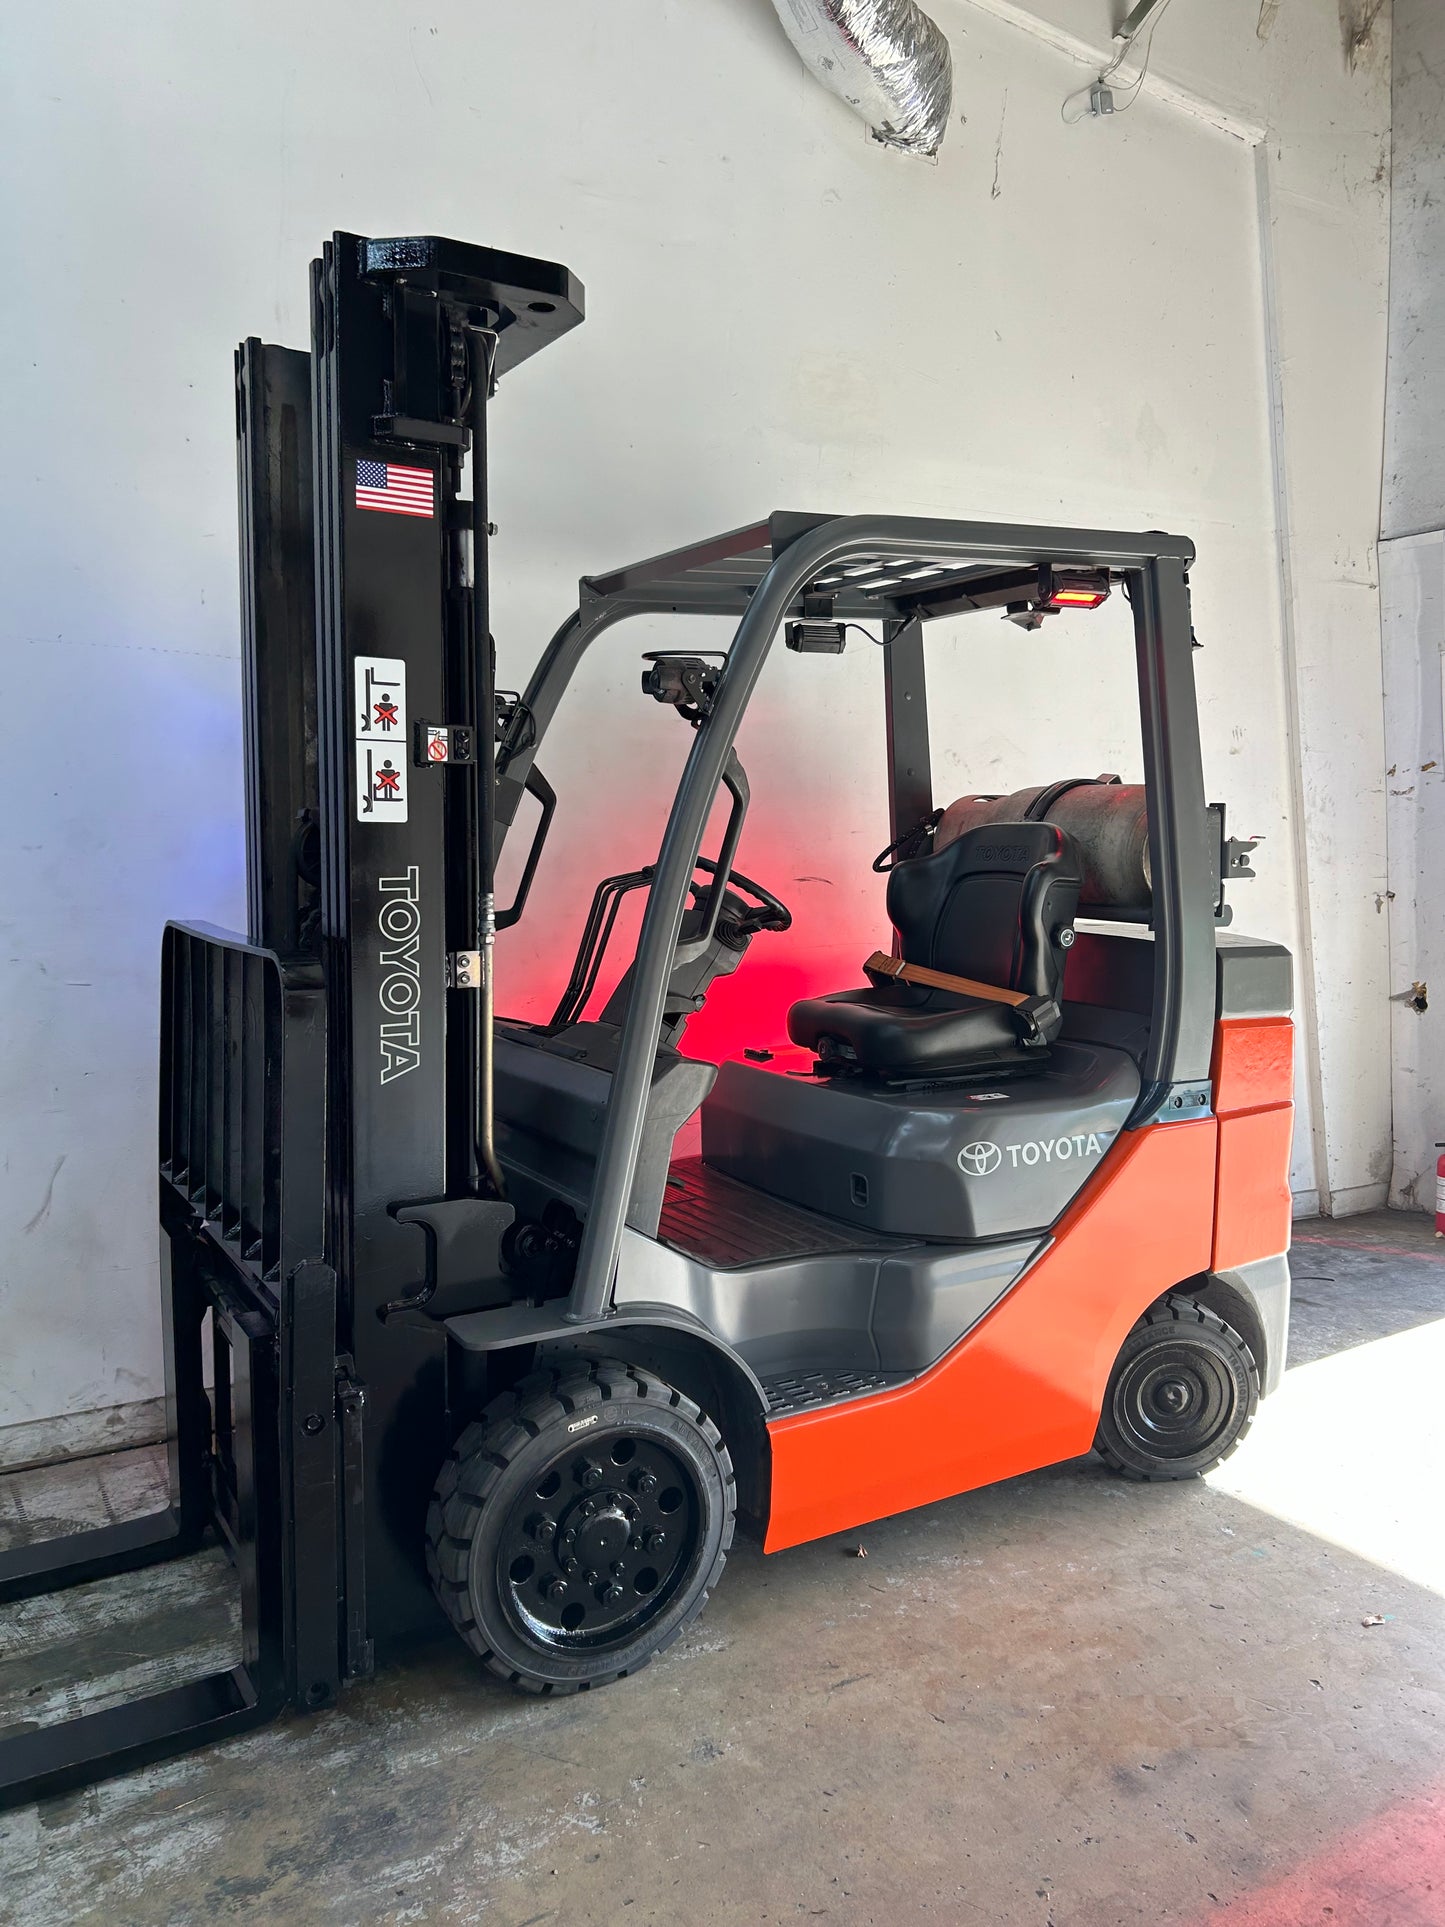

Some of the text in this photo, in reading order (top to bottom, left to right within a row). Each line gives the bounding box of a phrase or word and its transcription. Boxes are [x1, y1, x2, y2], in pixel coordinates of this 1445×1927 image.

[975, 845, 1031, 862] TOYOTA
[378, 865, 421, 1085] TOYOTA
[1006, 1133, 1101, 1168] TOYOTA
[1229, 1354, 1247, 1403] TRACTION
[670, 1420, 715, 1473] ADVANCE
